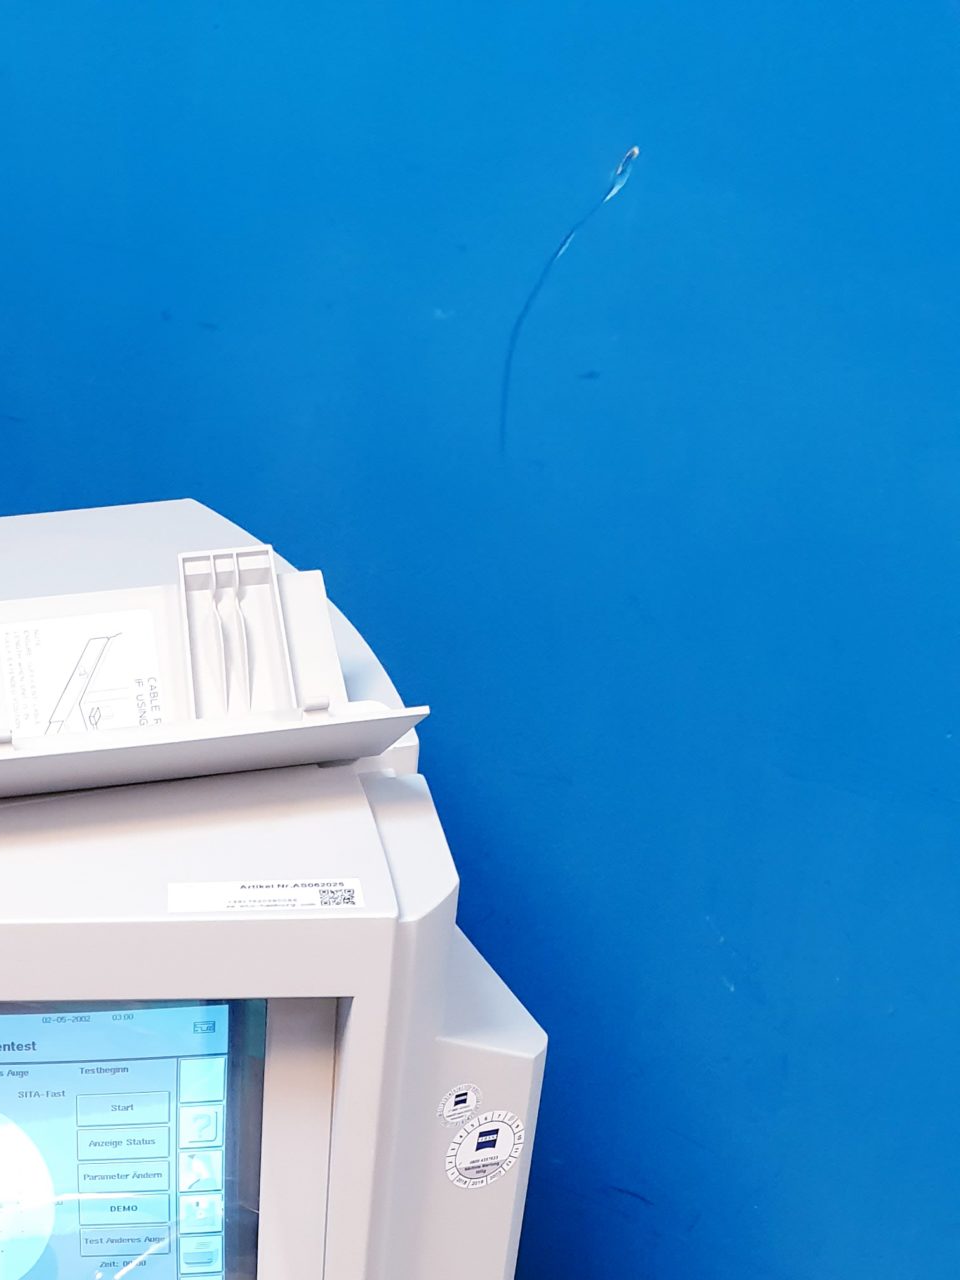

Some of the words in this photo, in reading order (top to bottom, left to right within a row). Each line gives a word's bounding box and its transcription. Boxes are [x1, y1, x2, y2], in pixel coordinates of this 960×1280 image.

[135, 679, 144, 687] IF
[147, 677, 161, 712] CABLE
[135, 694, 148, 727] USING
[6, 1069, 29, 1079] Auge
[80, 1066, 129, 1076] Testbeginn
[111, 1104, 134, 1112] Start
[89, 1139, 123, 1148] Anzeige
[126, 1138, 156, 1146] Status
[83, 1173, 129, 1181] Parameter
[132, 1170, 162, 1179] Ändern
[110, 1204, 138, 1213] DEMO
[84, 1237, 103, 1245] Test
[105, 1236, 141, 1244] Anderes
[144, 1235, 166, 1244] Auge
